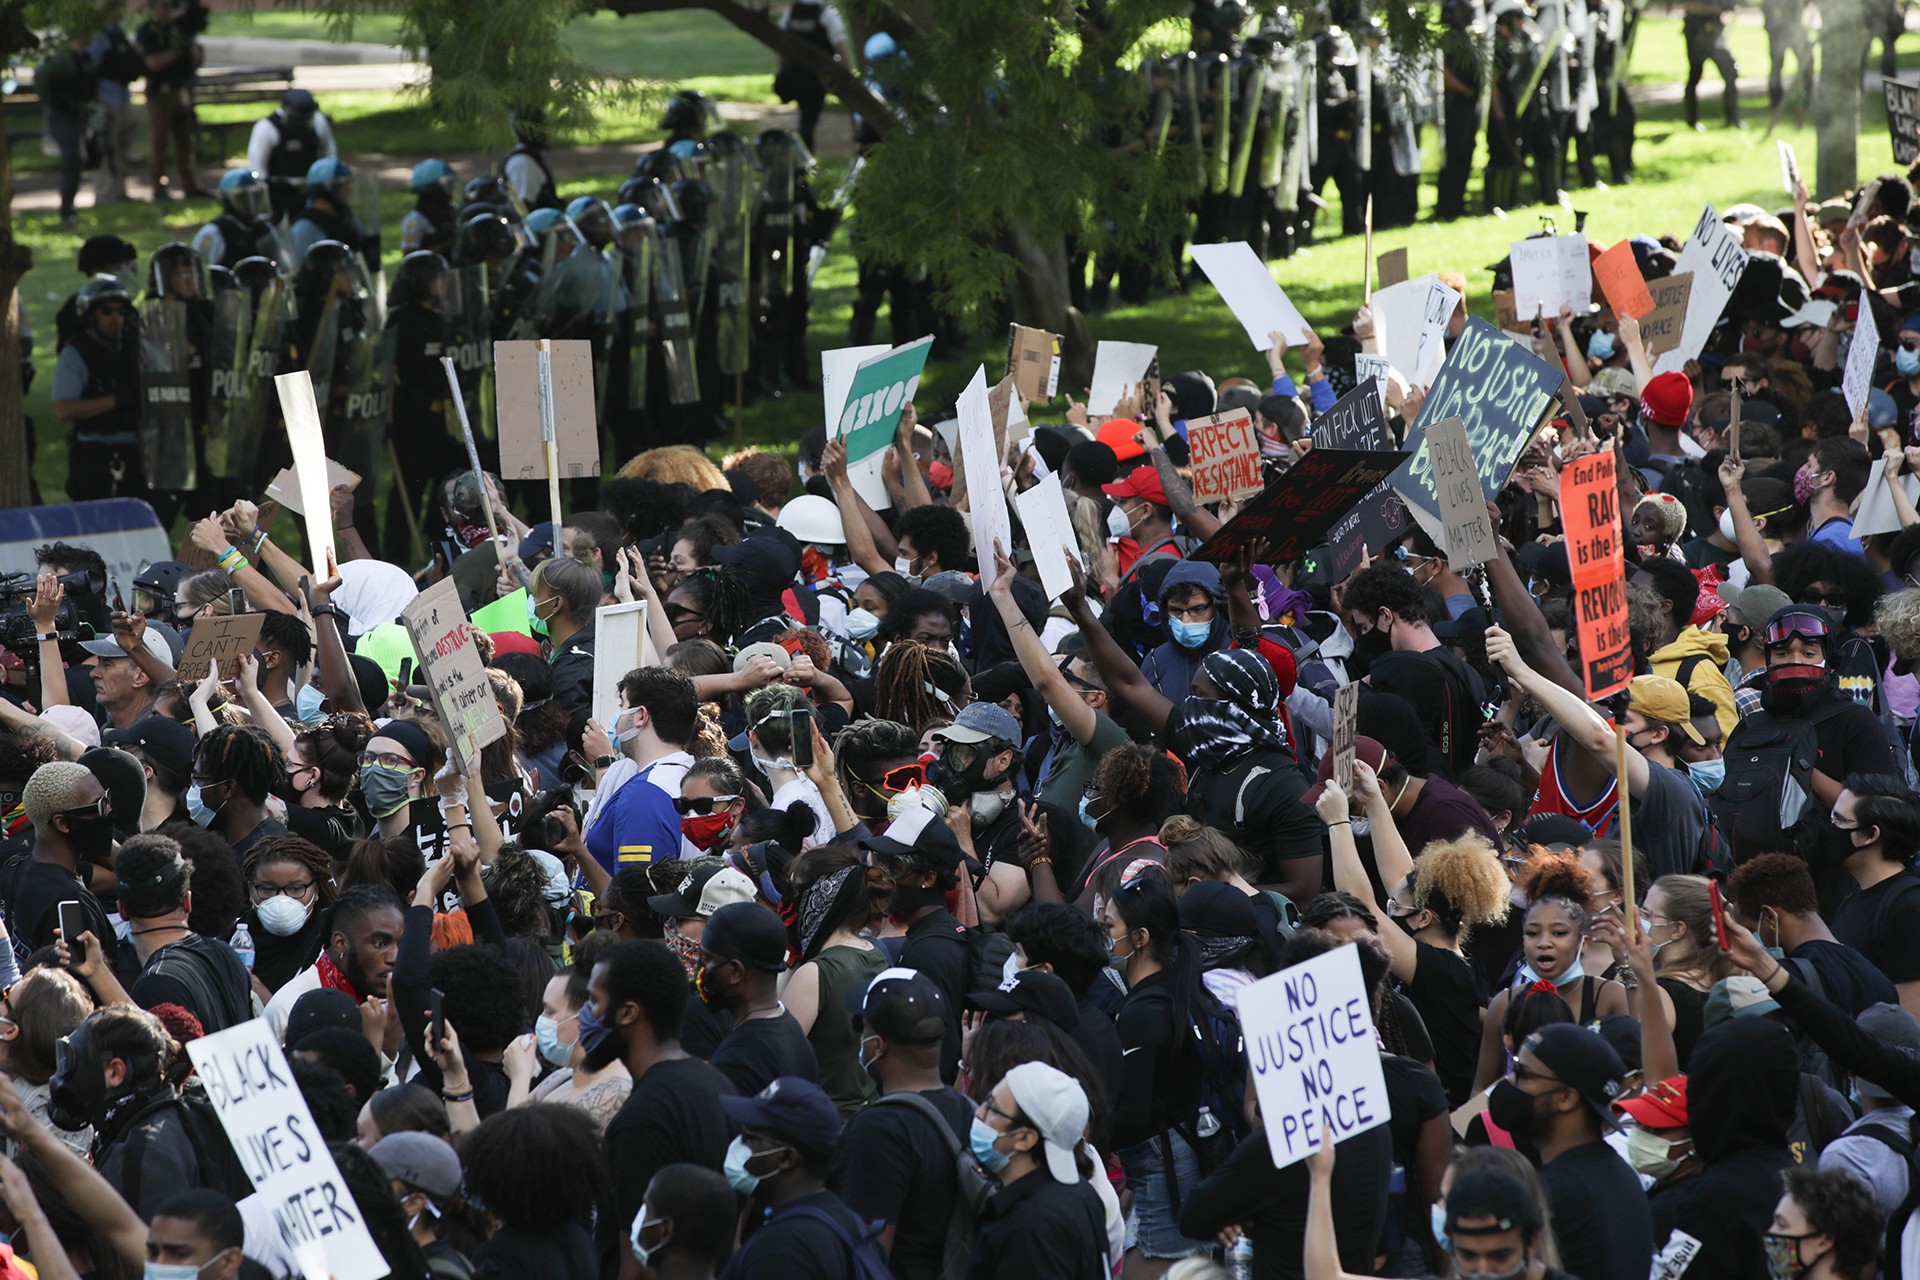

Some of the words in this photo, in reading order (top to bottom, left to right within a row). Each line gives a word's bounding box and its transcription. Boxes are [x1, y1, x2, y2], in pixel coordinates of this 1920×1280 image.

[1694, 206, 1717, 247] NO
[1711, 233, 1746, 292] LIVES
[1450, 325, 1490, 373] NO
[1210, 413, 1222, 424] OR
[1188, 417, 1250, 465] EXPECT
[1434, 439, 1471, 476] BLACK
[1194, 451, 1264, 499] RESISTANCE
[1447, 478, 1474, 508] LIVES
[1574, 464, 1594, 486] End
[1448, 516, 1487, 553] MATTER
[1576, 540, 1589, 565] is
[1591, 534, 1611, 561] the
[191, 636, 246, 658] CAN'T
[1596, 627, 1606, 652] is
[477, 681, 487, 698] or
[1338, 684, 1354, 725] STOP
[463, 700, 488, 731] NEW
[1285, 972, 1317, 1014] NO
[1256, 998, 1367, 1075] JUSTICE
[201, 1043, 288, 1111] BLACK
[1301, 1058, 1333, 1103] NO
[1282, 1086, 1374, 1155] PEACE
[236, 1114, 312, 1182] LIVES
[272, 1181, 355, 1250] MATTER
[1671, 1240, 1695, 1270] RISE
